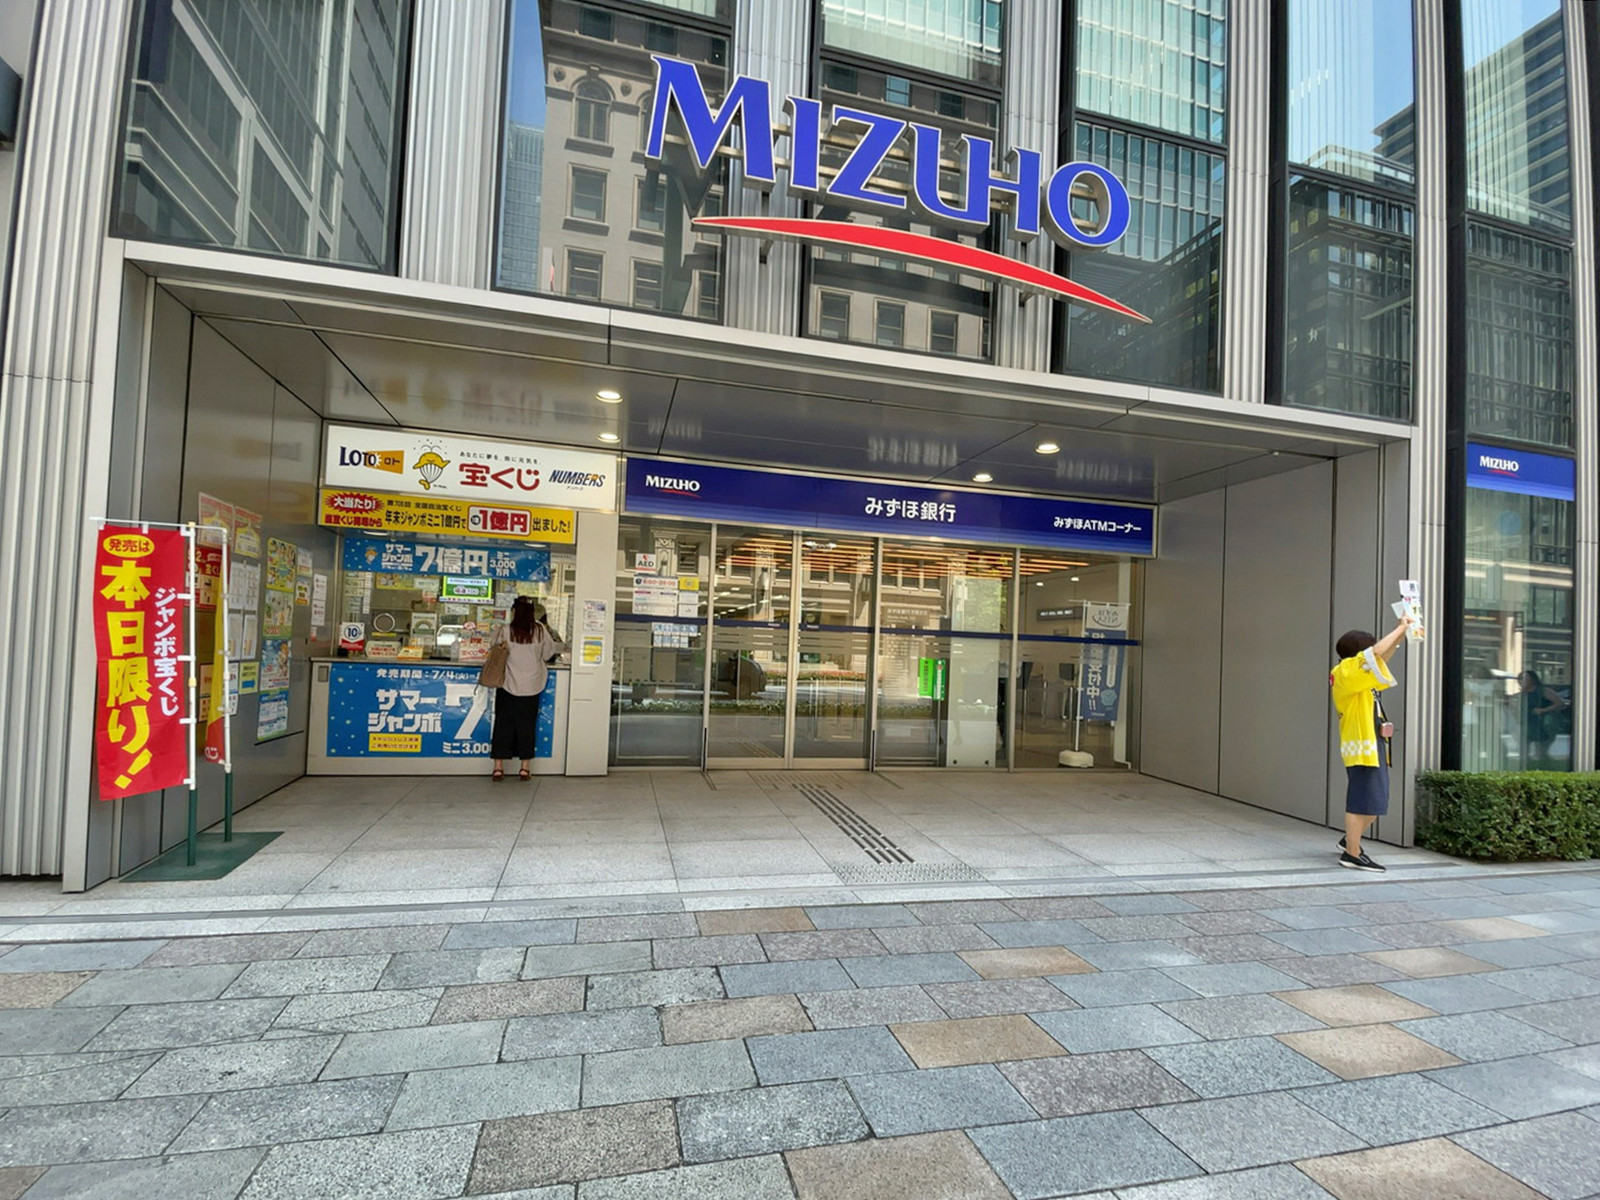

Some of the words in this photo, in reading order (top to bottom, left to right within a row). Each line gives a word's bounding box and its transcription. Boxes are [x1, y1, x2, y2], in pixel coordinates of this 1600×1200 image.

[645, 54, 1131, 249] MIZUHO
[339, 446, 377, 466] LOTO
[1479, 455, 1519, 472] MIZUHO
[458, 462, 541, 491] 宝くじ
[549, 469, 606, 488] NUMBERS
[645, 474, 701, 492] MIZUHO
[865, 497, 957, 522] みずほ銀行
[479, 509, 529, 533] 1億円
[1053, 516, 1142, 533] みずほATMコーナー
[108, 537, 151, 553] 発売は
[384, 543, 412, 553] サマー
[415, 545, 490, 575] 7億円
[347, 627, 358, 638] 10
[154, 586, 181, 716] ジャンボ宝くじ
[100, 559, 153, 790] 本日限り！
[376, 688, 438, 711] サマー
[367, 712, 442, 733] ジャンボ
